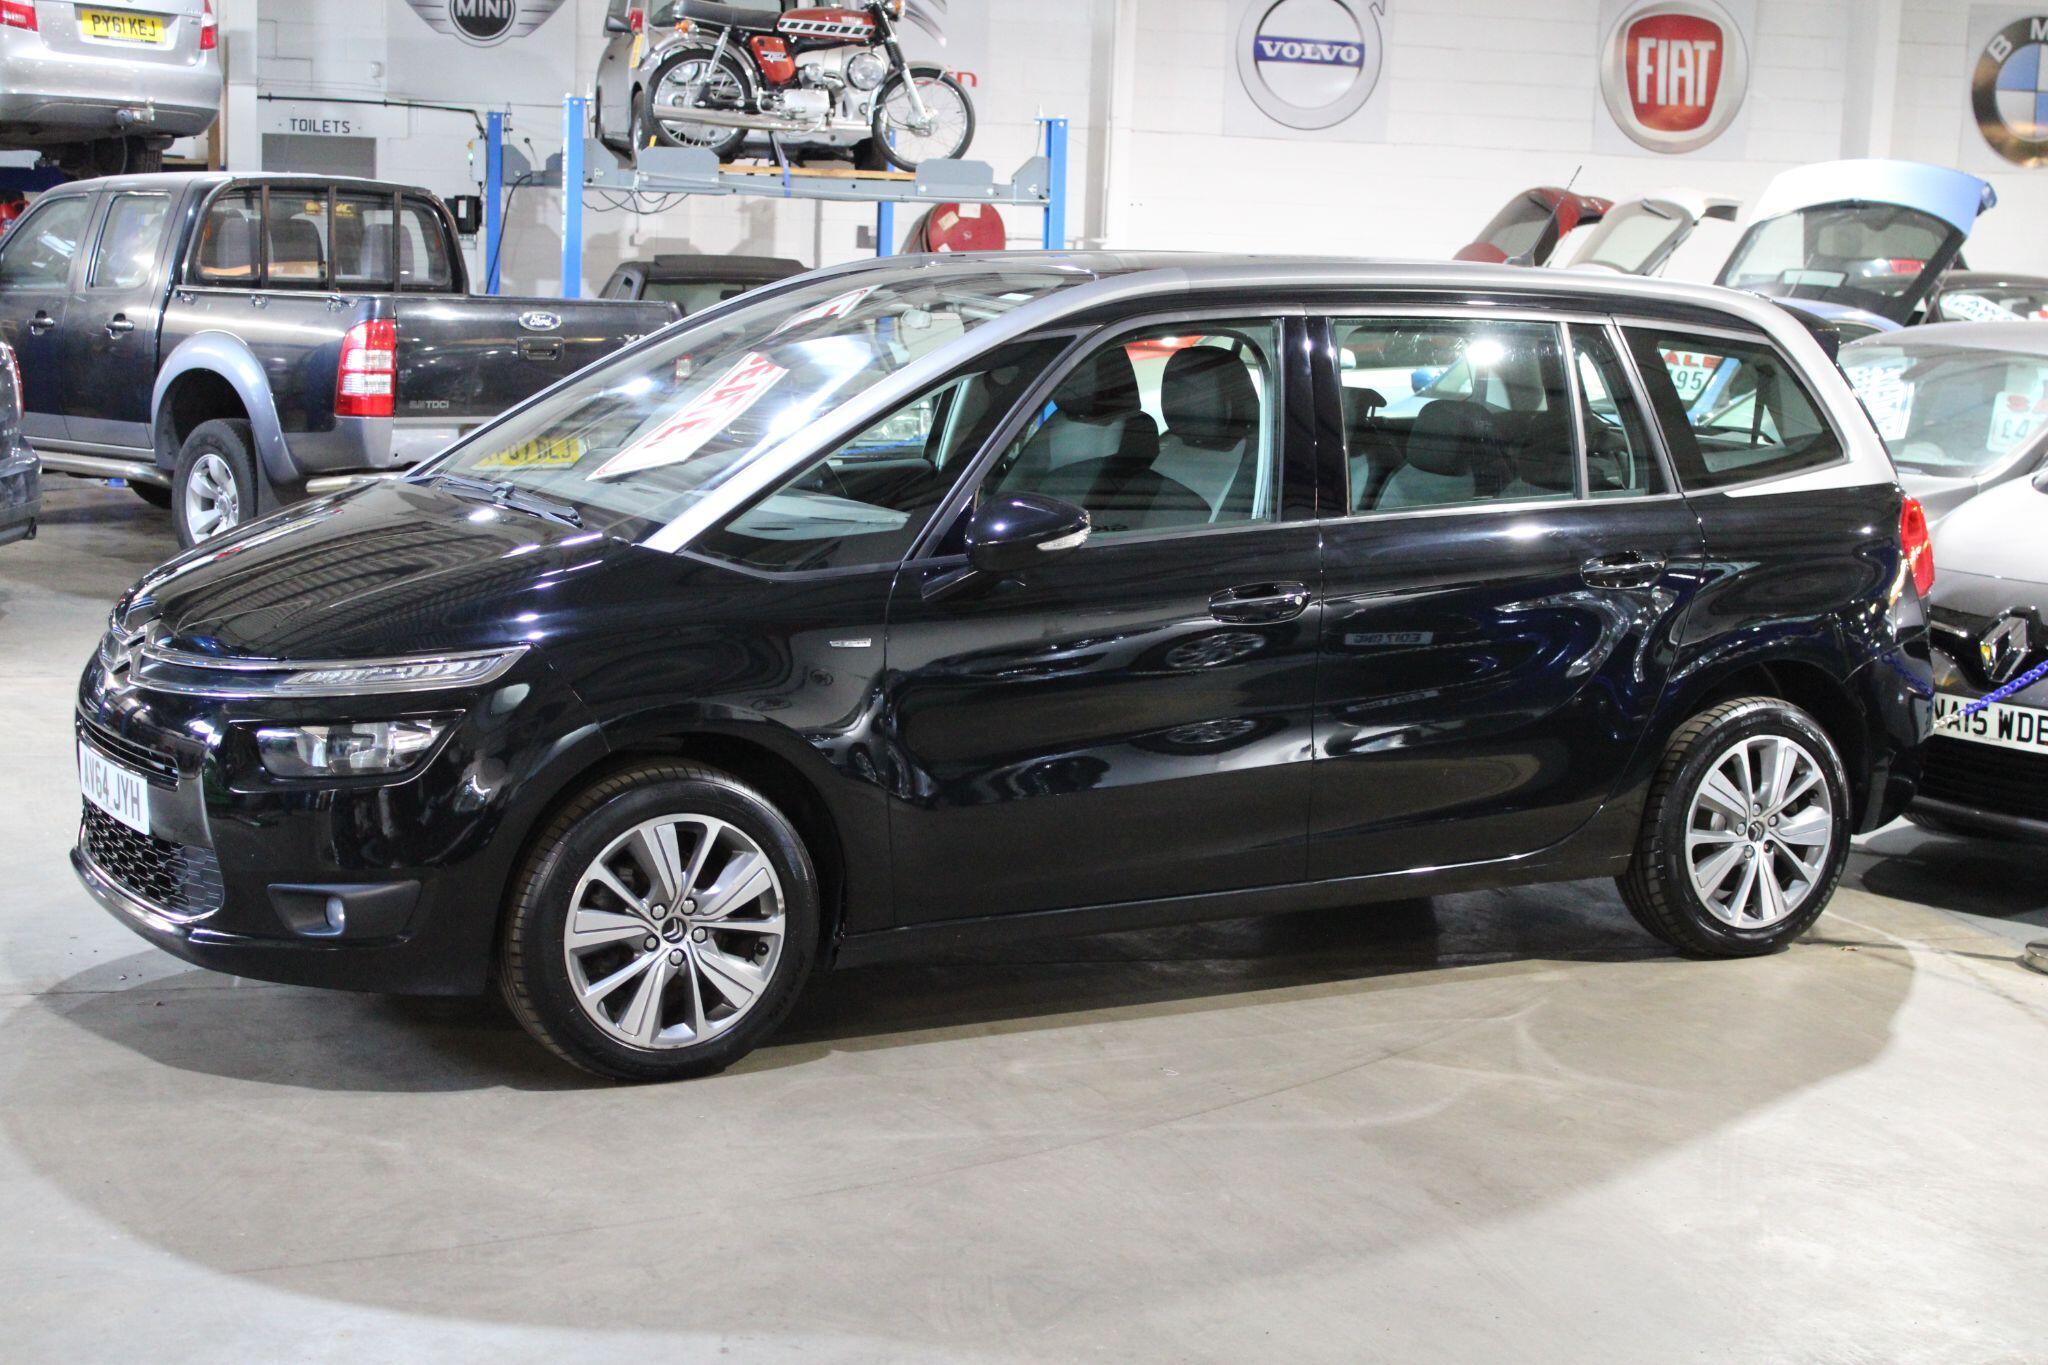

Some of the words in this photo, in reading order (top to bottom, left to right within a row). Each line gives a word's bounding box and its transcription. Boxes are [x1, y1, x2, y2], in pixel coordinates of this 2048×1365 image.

[456, 0, 510, 18] MINI
[1258, 40, 1360, 63] VOLVO
[1637, 37, 1717, 107] FIAT
[290, 118, 351, 134] TOILETS
[1663, 351, 1721, 370] ALE
[113, 772, 141, 822] JYH
